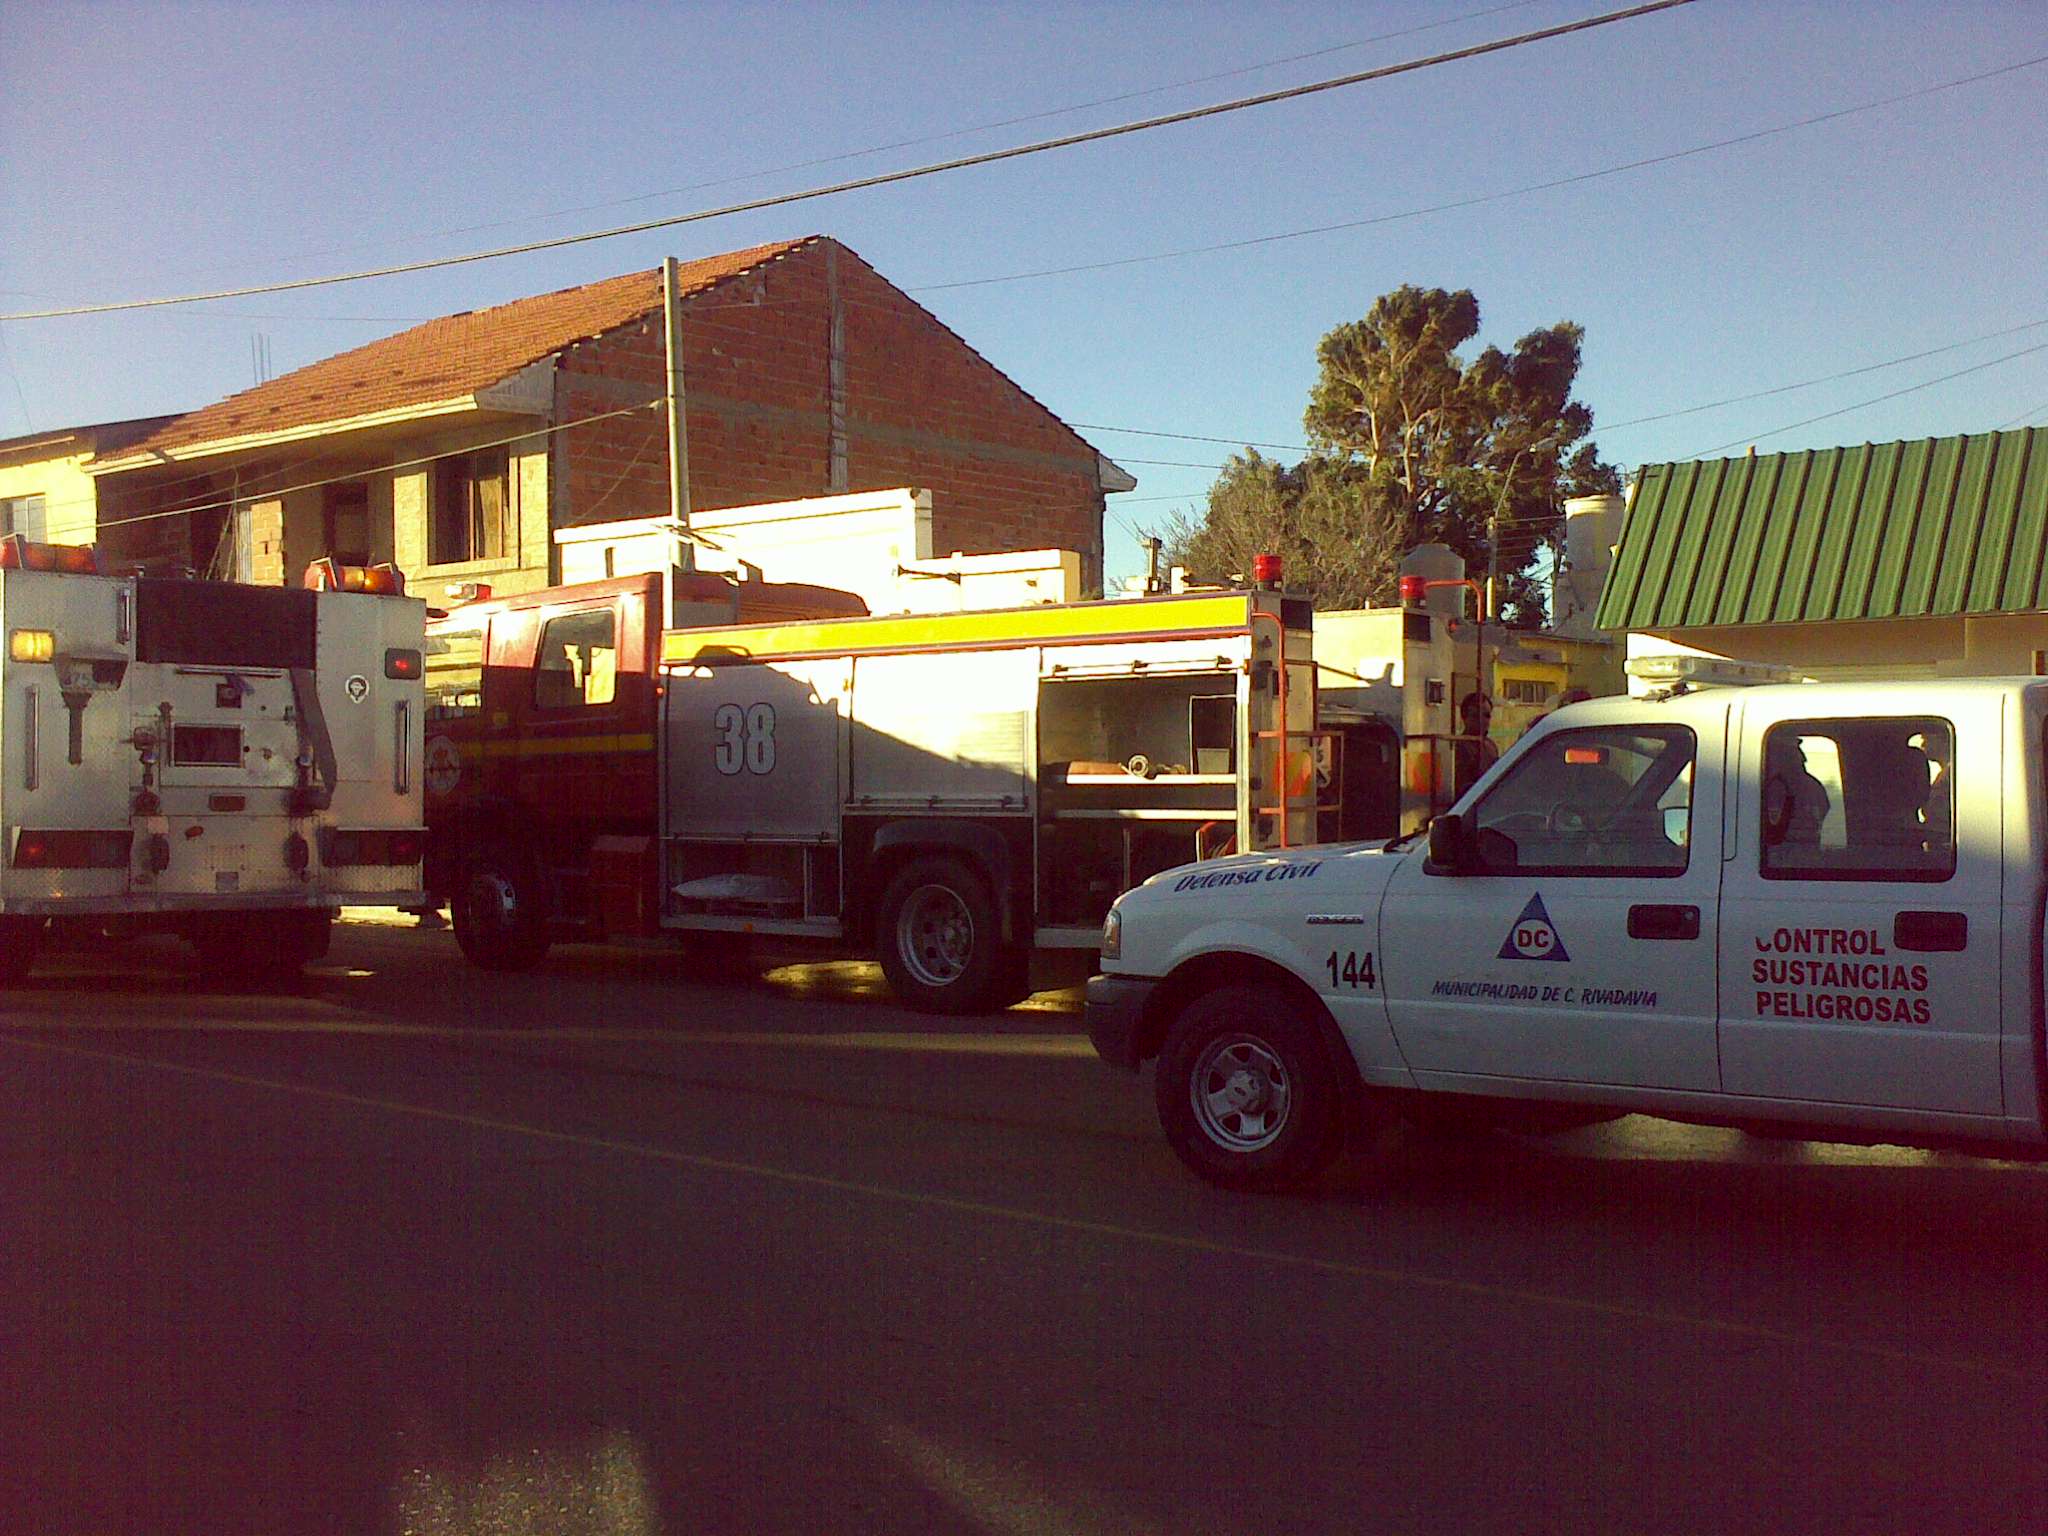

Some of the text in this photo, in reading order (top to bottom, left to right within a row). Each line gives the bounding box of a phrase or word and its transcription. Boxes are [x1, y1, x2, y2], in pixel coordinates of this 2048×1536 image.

[714, 702, 776, 776] 38
[1174, 860, 1324, 893] Defensa Civil
[1517, 928, 1550, 948] DC
[1326, 950, 1376, 989] 144
[1752, 958, 1929, 992] SUSTANCIAS
[1432, 980, 1538, 1000] MUNICIPALIDAD
[1541, 985, 1561, 1002] DE
[1581, 988, 1658, 1007] RIVADAVIA
[1756, 991, 1932, 1024] PELIGROSAS
